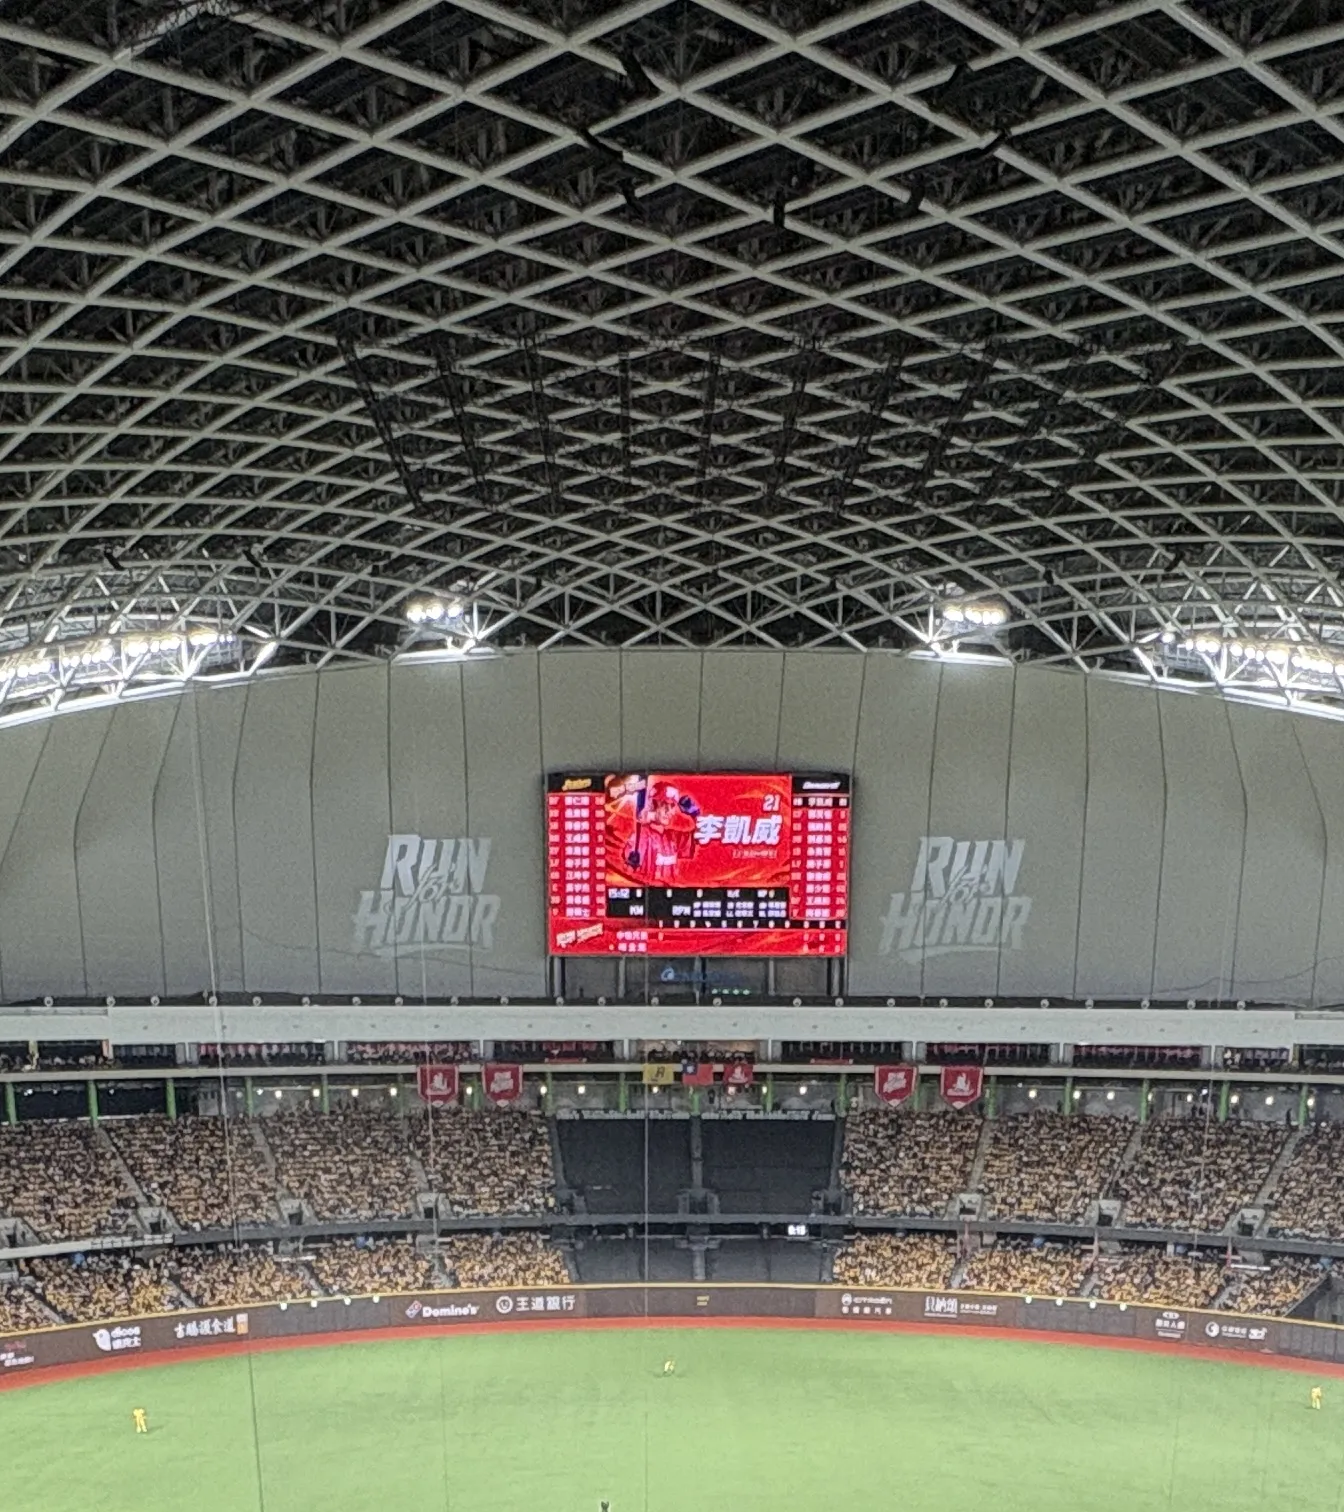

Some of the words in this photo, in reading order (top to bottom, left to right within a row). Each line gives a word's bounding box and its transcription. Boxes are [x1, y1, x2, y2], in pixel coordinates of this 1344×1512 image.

[762, 794, 781, 812] 21
[693, 815, 783, 845] 李凱威
[380, 834, 492, 896] RUN
[911, 836, 1026, 898] RUN
[352, 890, 502, 951] HONOR
[878, 892, 1034, 955] HONOR
[422, 1303, 481, 1318] Domino's
[516, 1295, 576, 1312] 王道銀行
